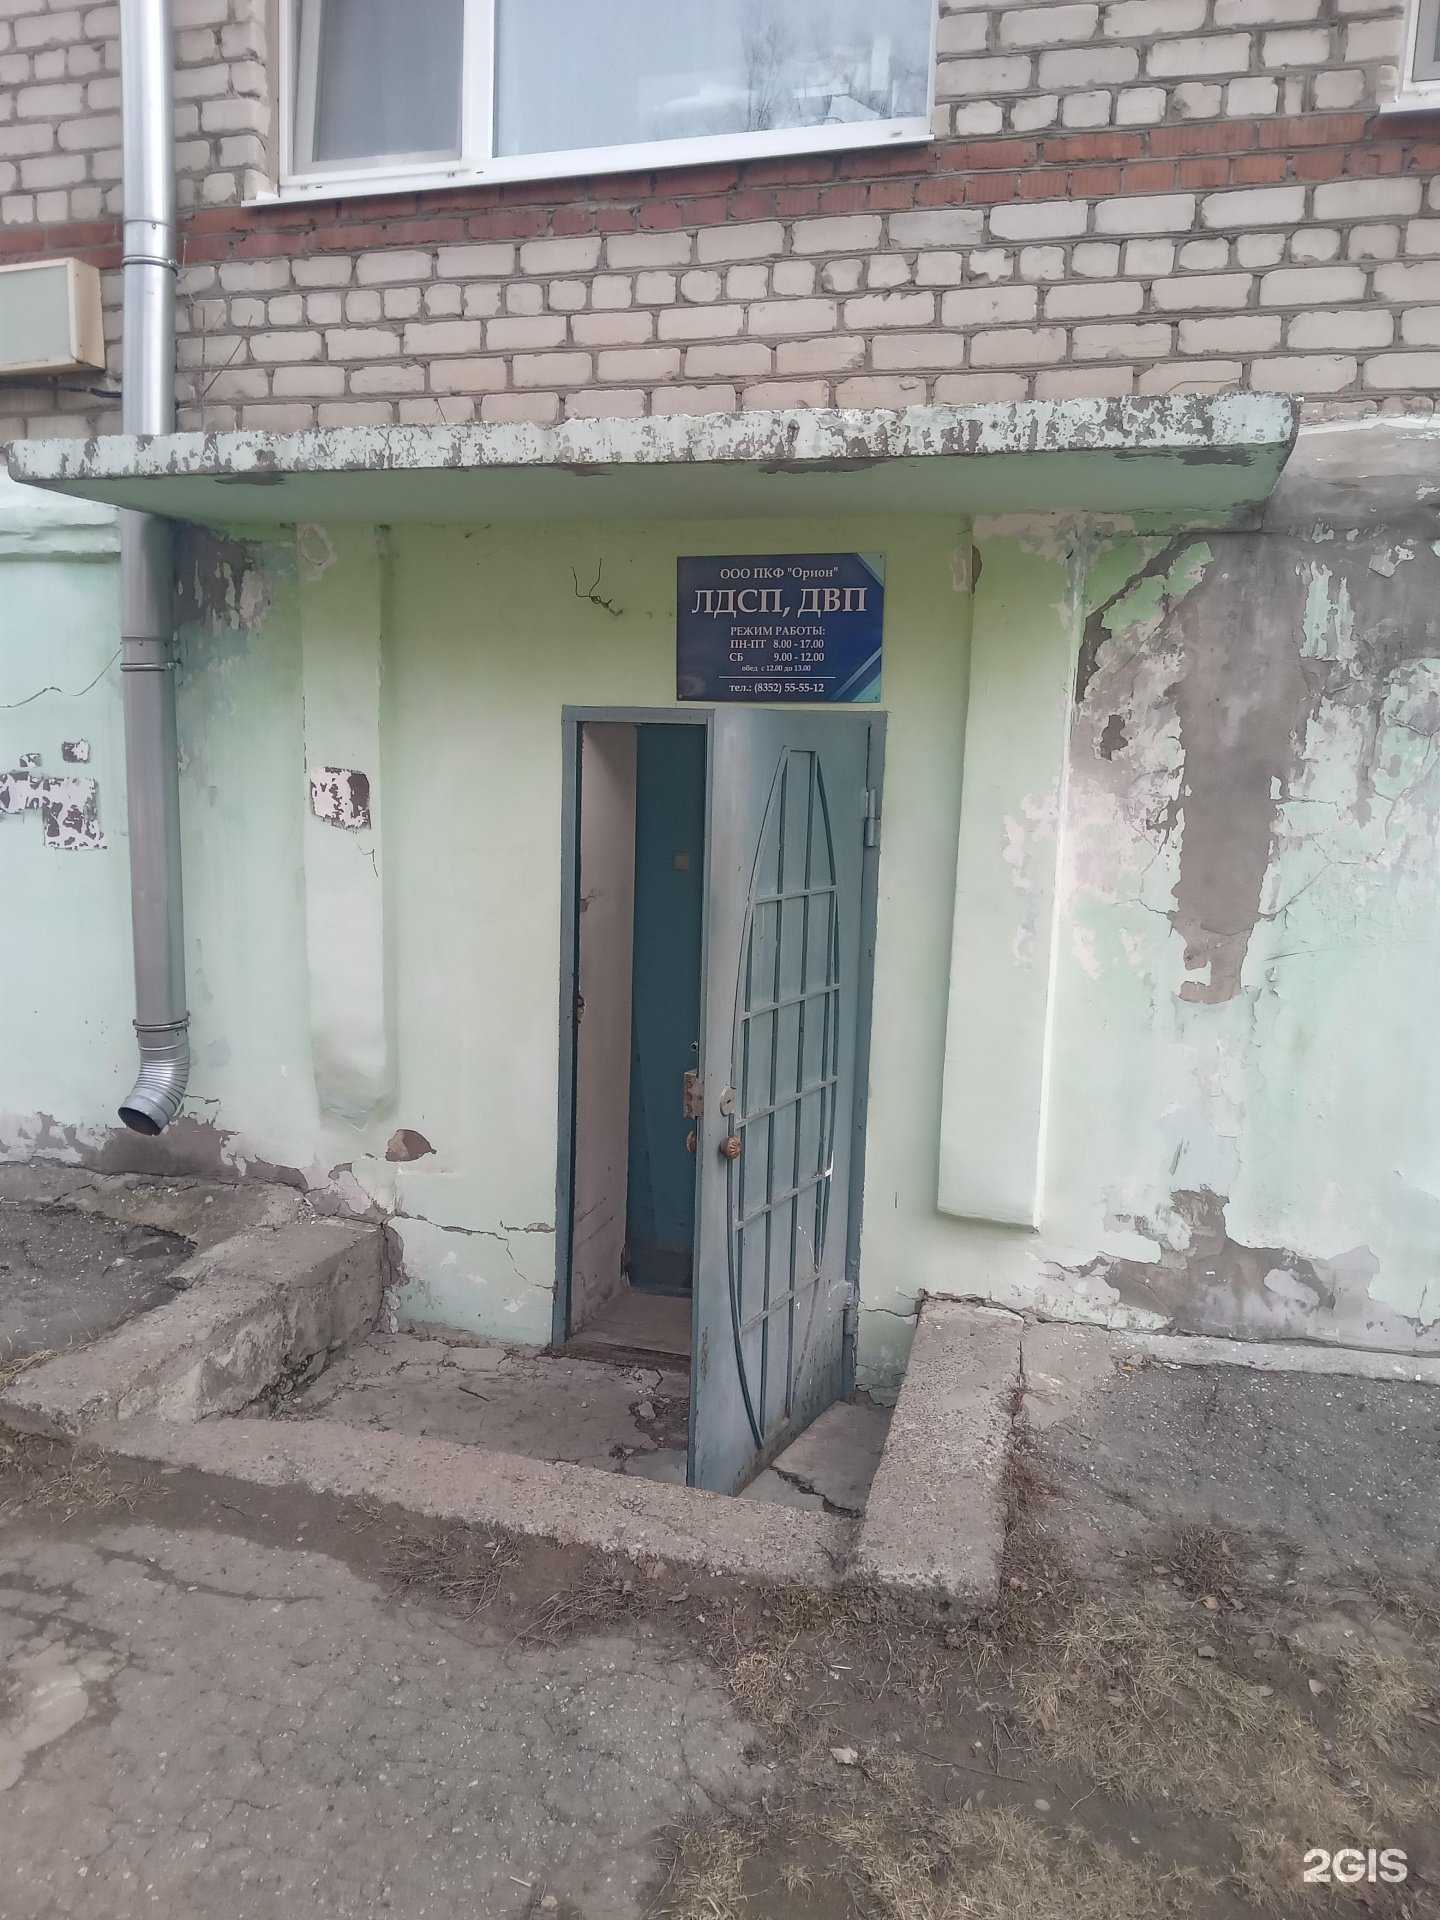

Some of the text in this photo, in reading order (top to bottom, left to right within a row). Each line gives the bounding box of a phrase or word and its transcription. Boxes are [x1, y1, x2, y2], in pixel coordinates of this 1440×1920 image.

[720, 567, 838, 580] ООО ПКФ "Орион"
[692, 588, 868, 618] ЛДСП, ДВП
[730, 627, 825, 635] РЕЖИМ РАБОТЫ:
[774, 653, 792, 661] 9.00
[800, 653, 824, 661] 12.00
[754, 684, 782, 693] (8352)
